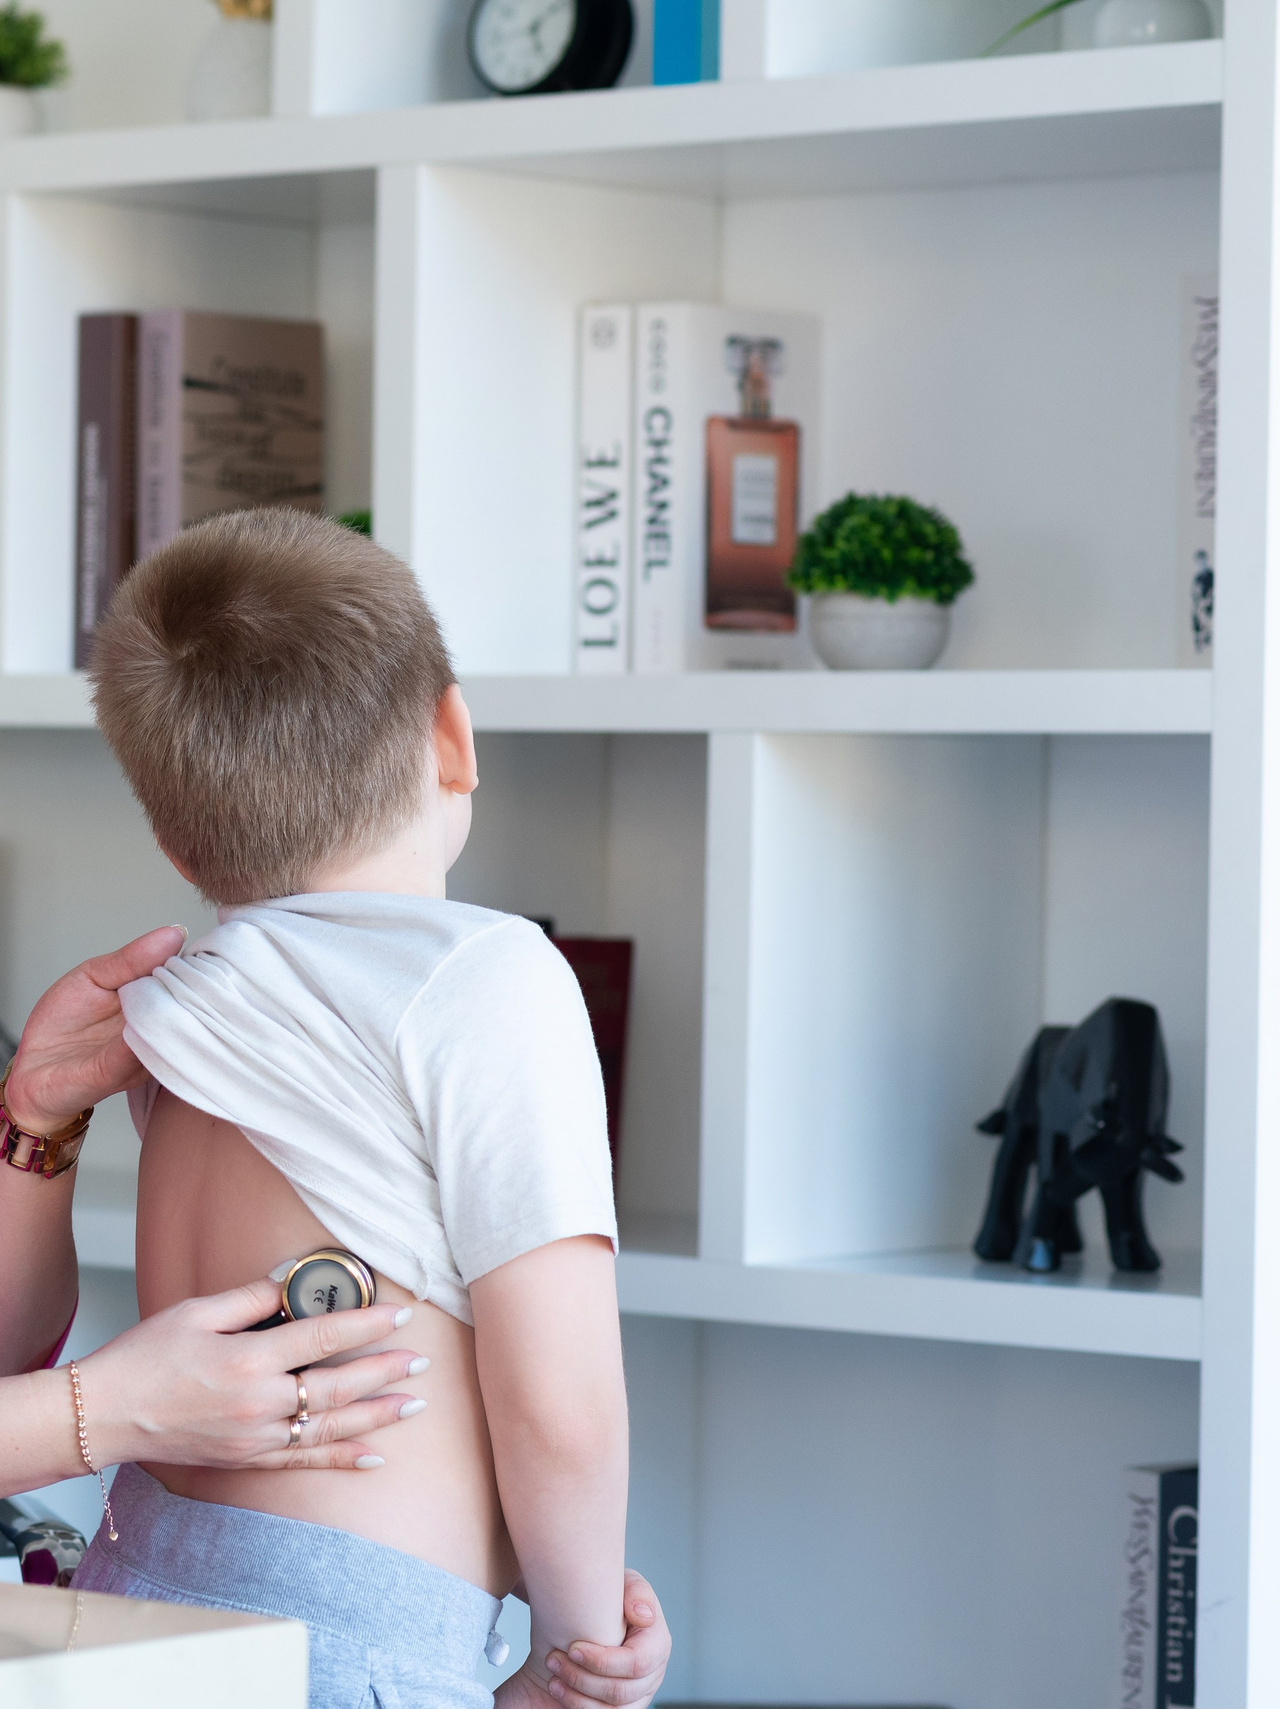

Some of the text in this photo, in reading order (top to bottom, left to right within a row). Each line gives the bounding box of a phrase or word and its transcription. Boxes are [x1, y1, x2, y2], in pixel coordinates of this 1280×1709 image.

[580, 438, 621, 650] LOEWE
[643, 404, 673, 584] CHANEL
[325, 1284, 339, 1314] KaWe
[1166, 1504, 1198, 1683] Christian
